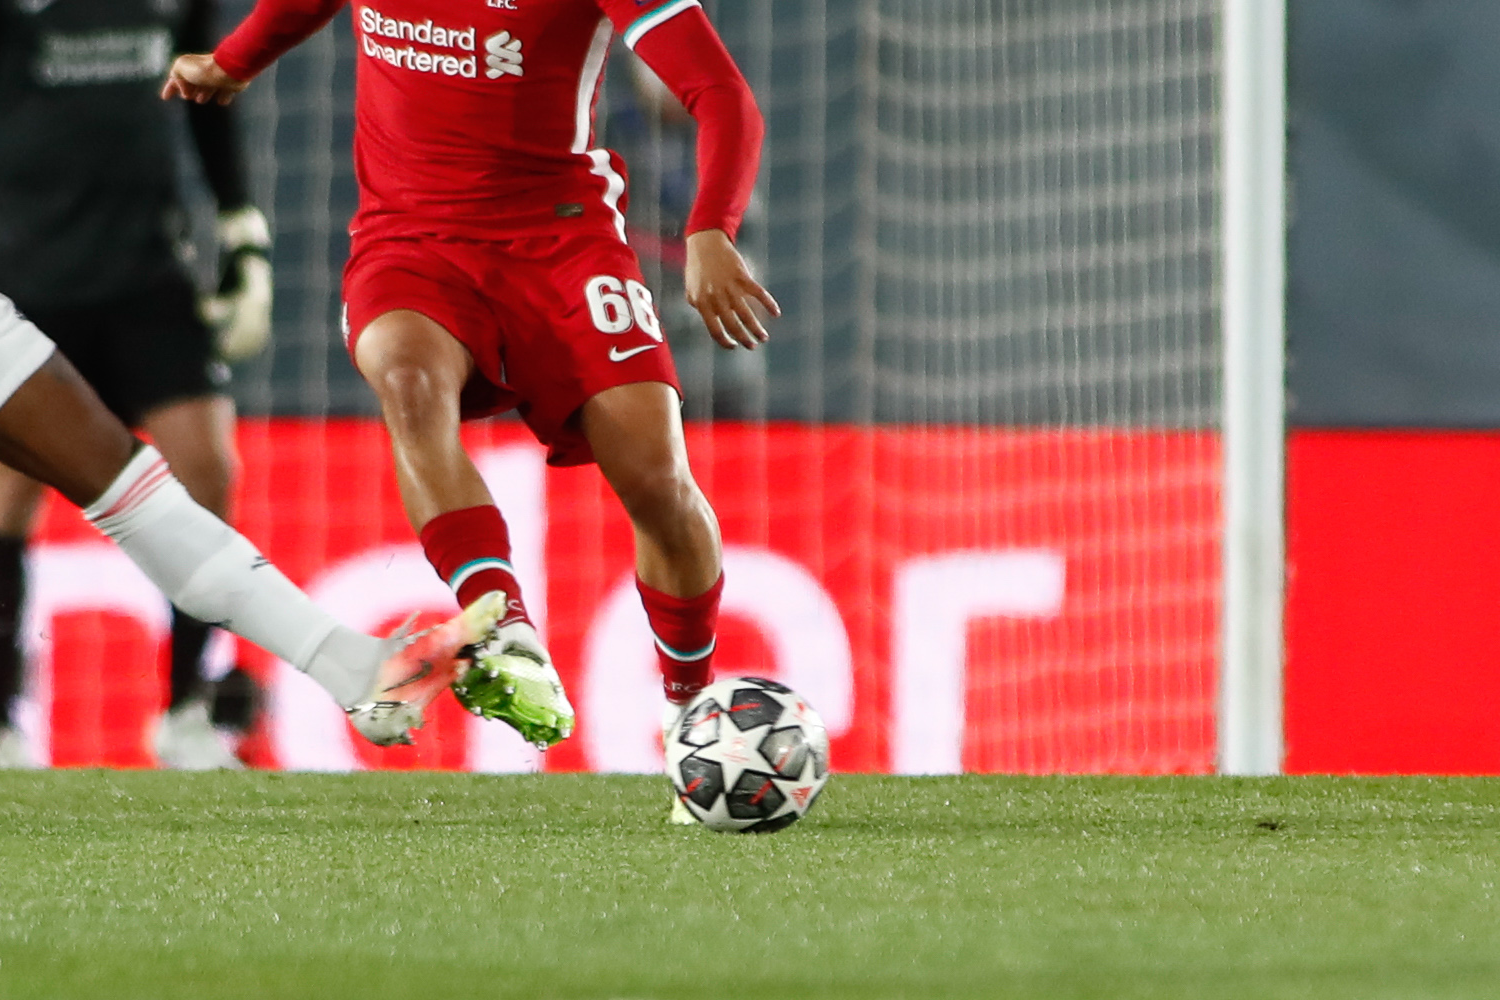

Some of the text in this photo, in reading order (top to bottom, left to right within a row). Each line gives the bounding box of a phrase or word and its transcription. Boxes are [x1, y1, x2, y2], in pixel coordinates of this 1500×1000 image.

[360, 7, 476, 51] Standard
[362, 33, 477, 79] Chartered
[585, 275, 663, 343] 66
